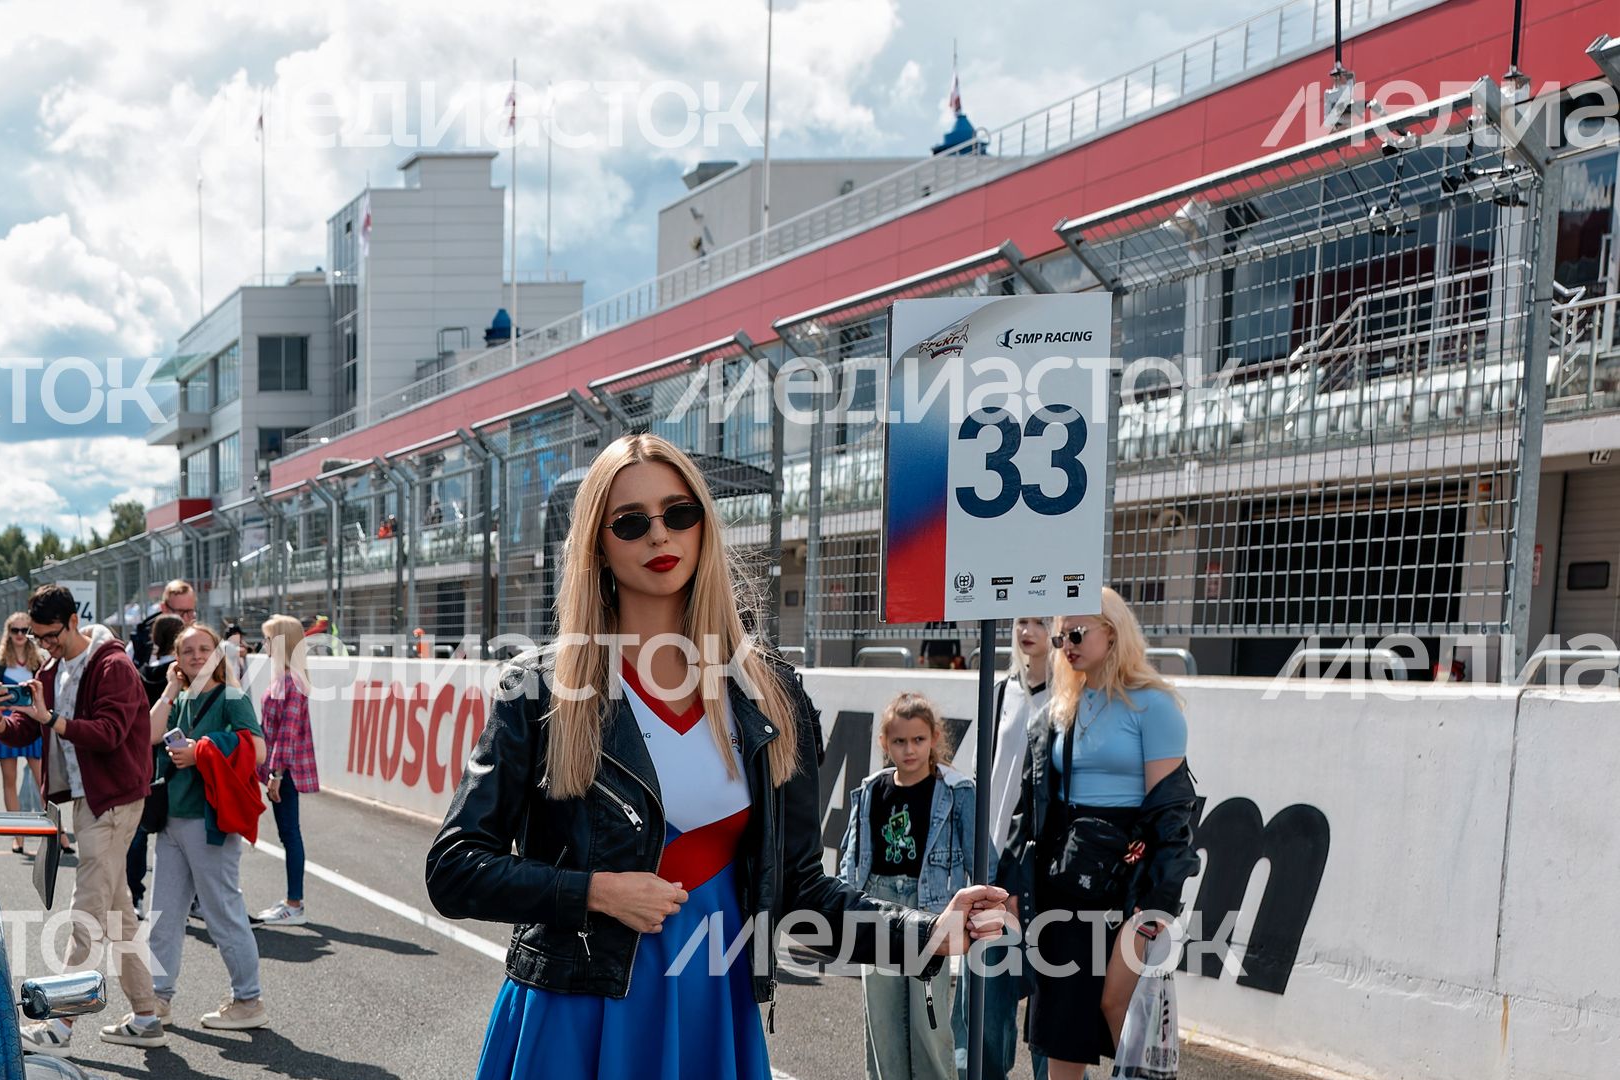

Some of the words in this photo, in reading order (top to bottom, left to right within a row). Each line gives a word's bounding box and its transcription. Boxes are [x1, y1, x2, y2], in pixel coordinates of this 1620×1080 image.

[1014, 332, 1043, 345] SMP
[1044, 331, 1093, 344] RACING
[954, 403, 1089, 519] 33
[347, 680, 490, 795] MOSCO
